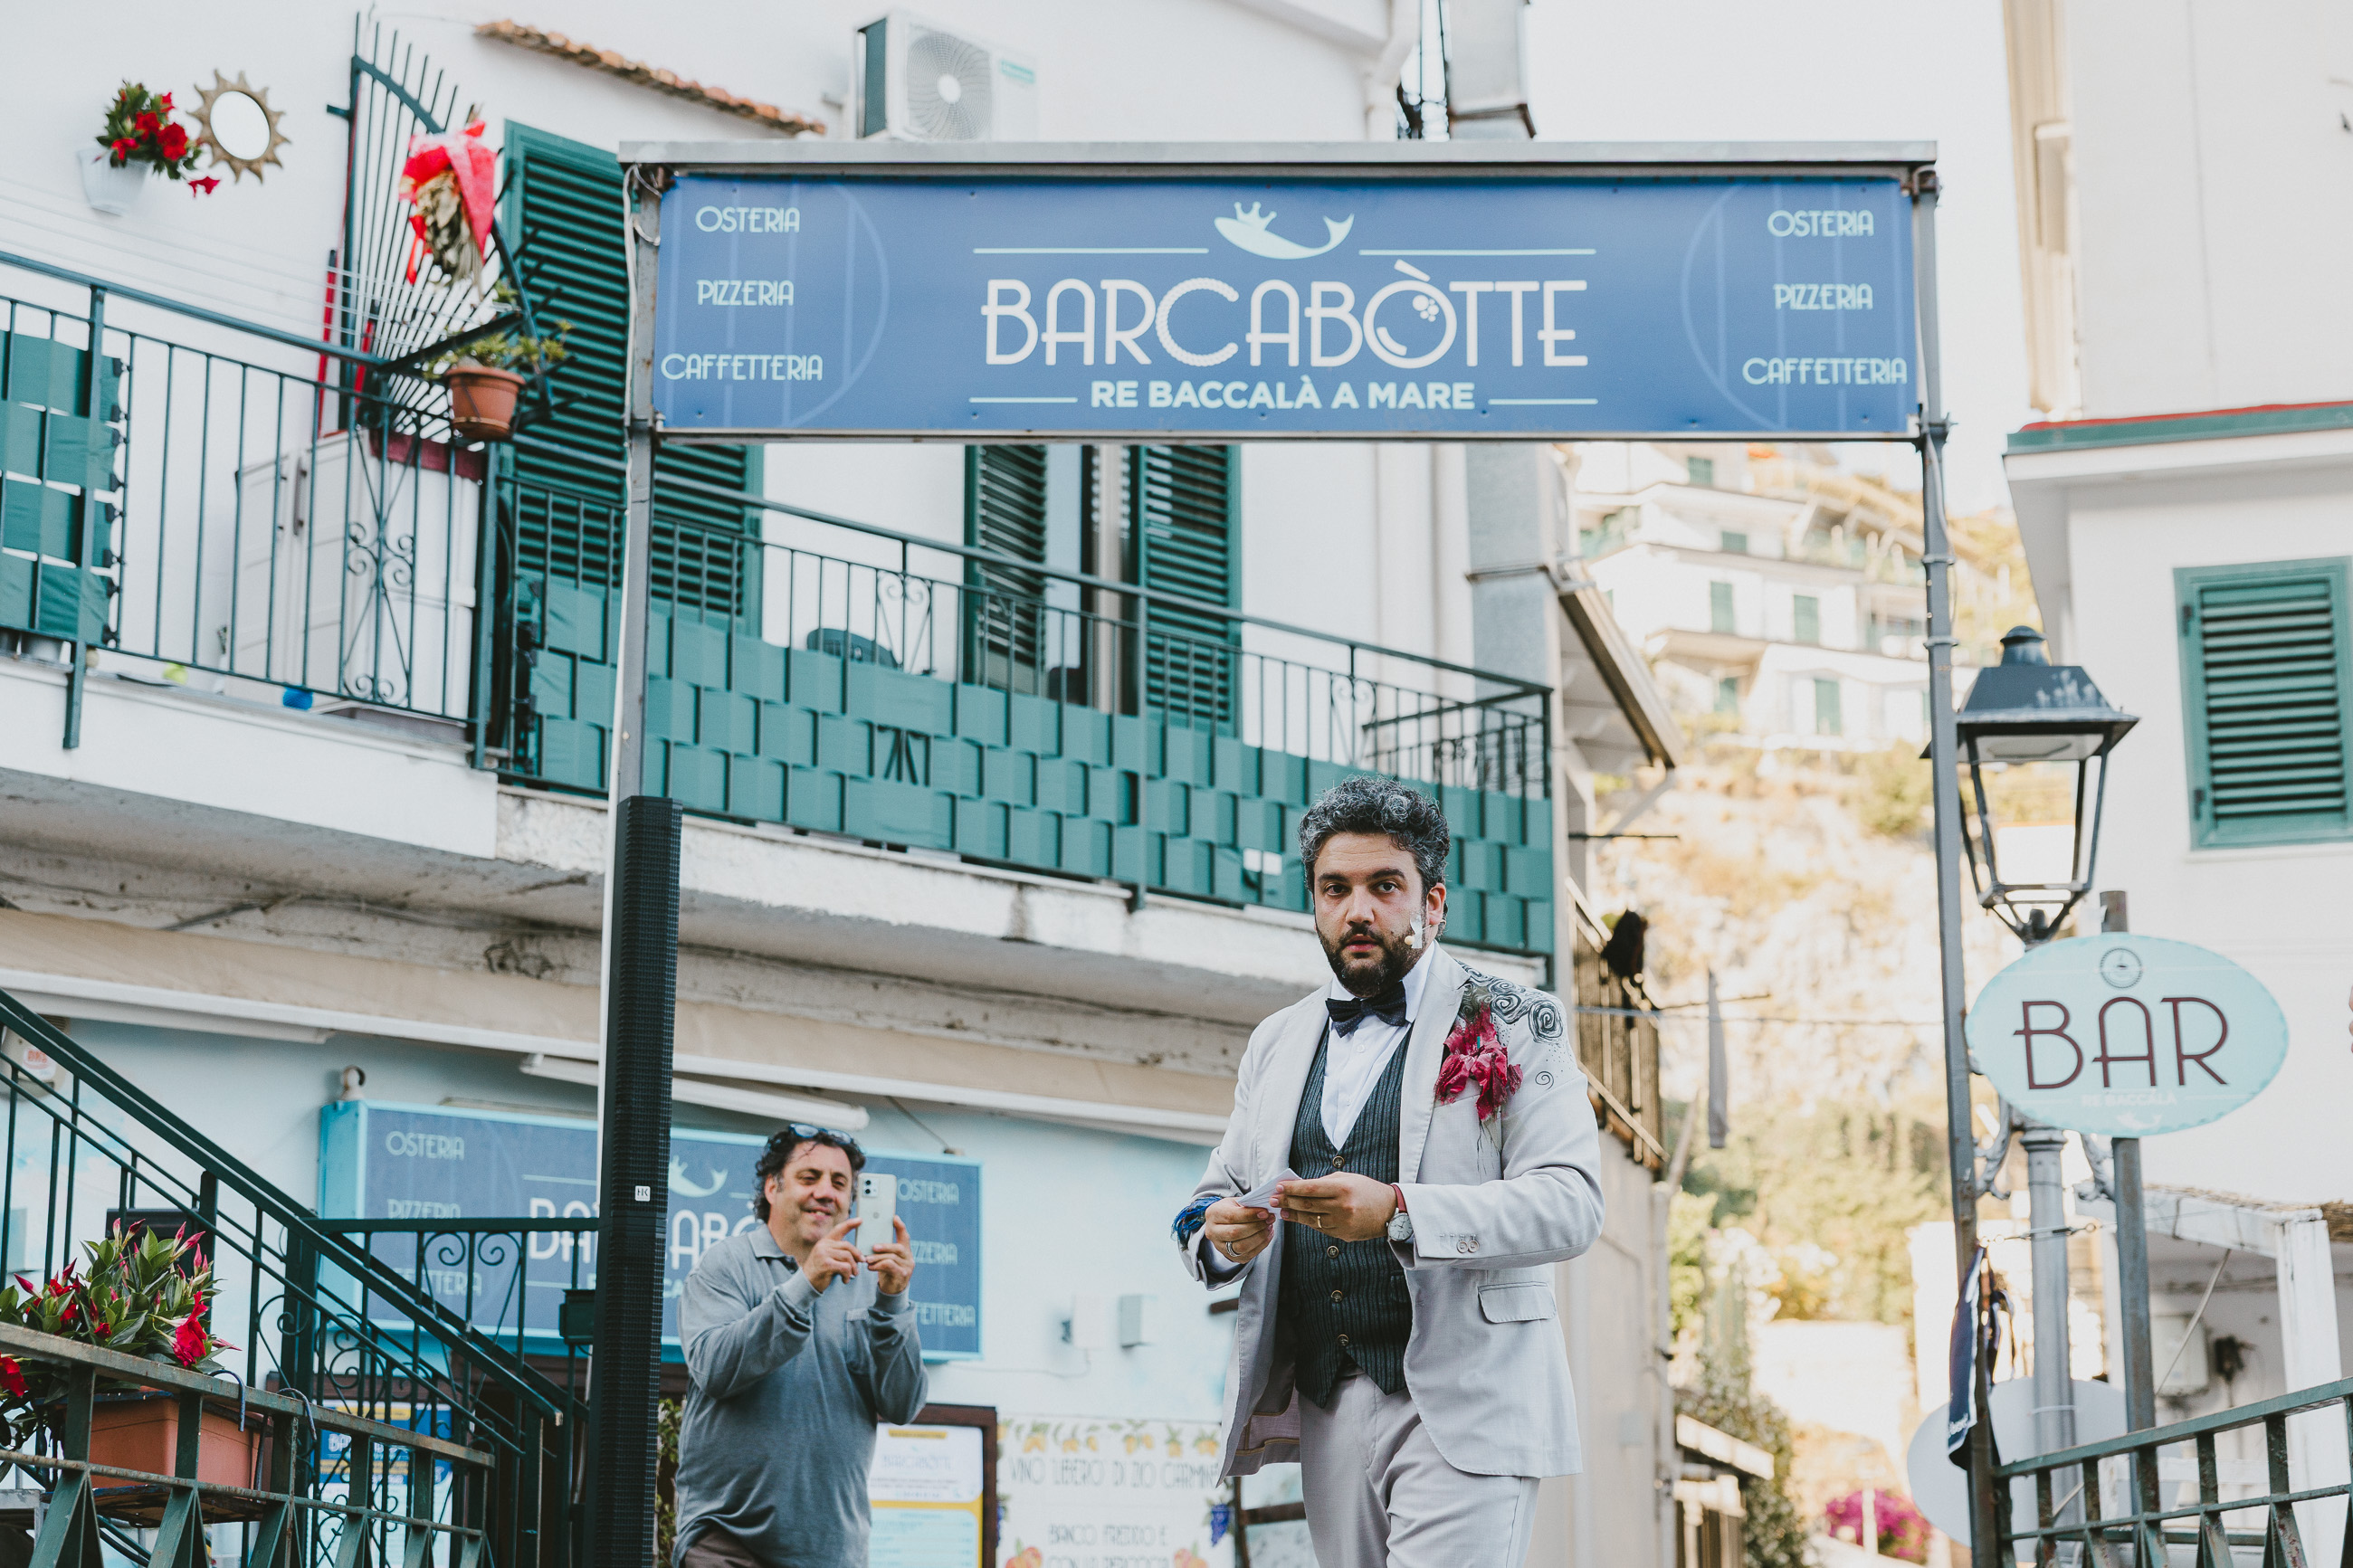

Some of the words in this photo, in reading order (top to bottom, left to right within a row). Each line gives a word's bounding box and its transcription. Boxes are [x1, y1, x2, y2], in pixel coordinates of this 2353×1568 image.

[695, 205, 801, 234] OSTERIA
[1767, 209, 1874, 238] OSTERIA
[697, 279, 795, 307] PIZZERIA
[1774, 282, 1873, 312] PIZZERIA
[981, 258, 1589, 367] BARCABÒTTE
[661, 353, 824, 382] CAFFETTERIA
[1742, 356, 1908, 386] CAFFETTERIA
[1091, 380, 1139, 409] RE
[1148, 374, 1323, 410] BACCALÀ
[1330, 381, 1361, 409] A
[1367, 381, 1475, 410] MARE
[2013, 996, 2229, 1090] BAR
